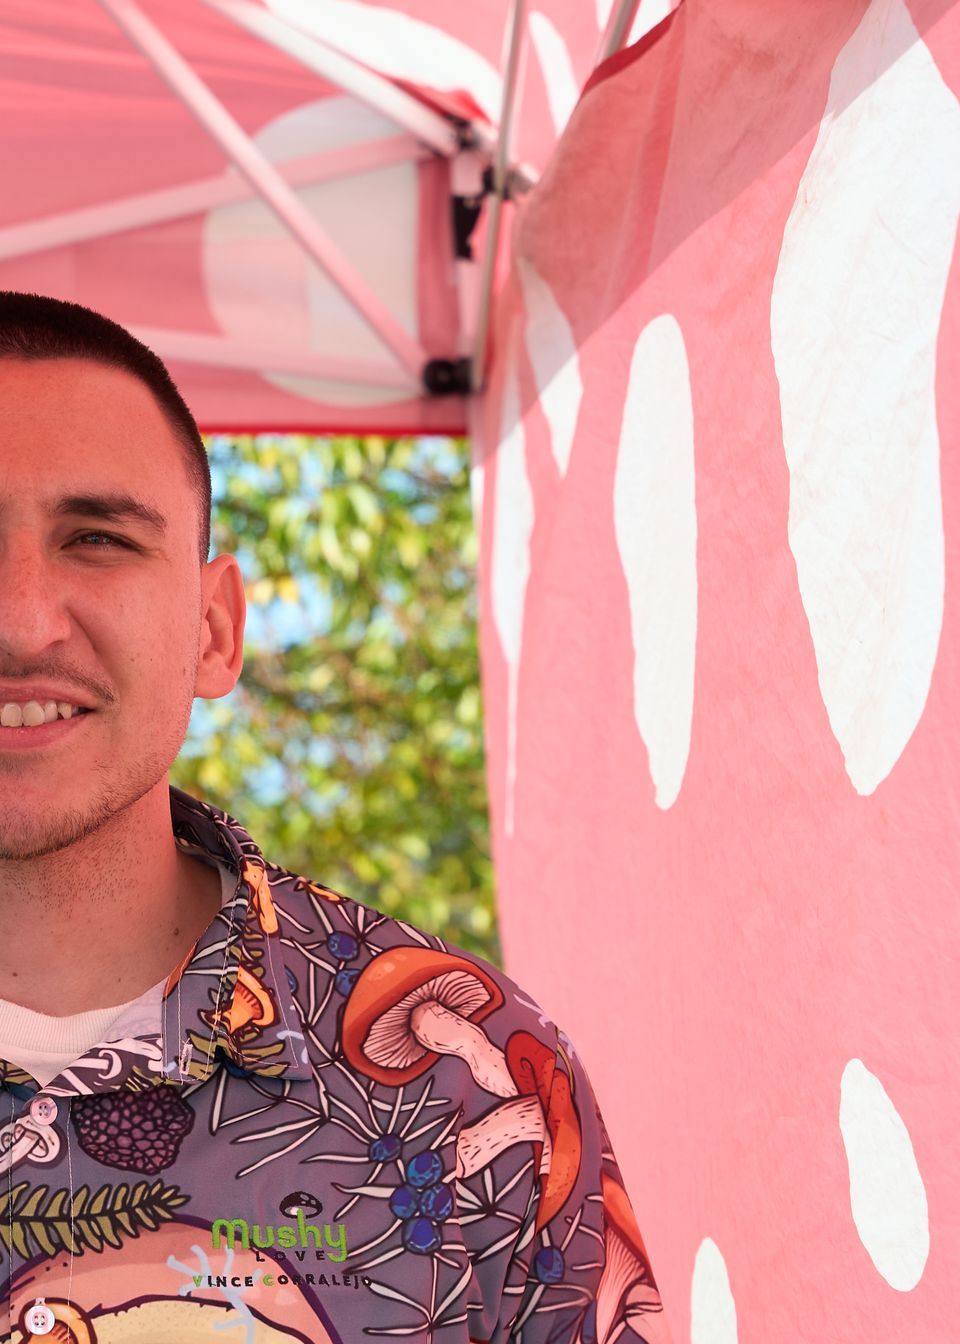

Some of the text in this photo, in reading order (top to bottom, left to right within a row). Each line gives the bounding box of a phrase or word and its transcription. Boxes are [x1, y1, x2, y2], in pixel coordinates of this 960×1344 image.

[212, 1208, 348, 1262] Mushy
[256, 1251, 326, 1262] LOVE
[192, 1274, 372, 1290] VINCE CORRALEJO
